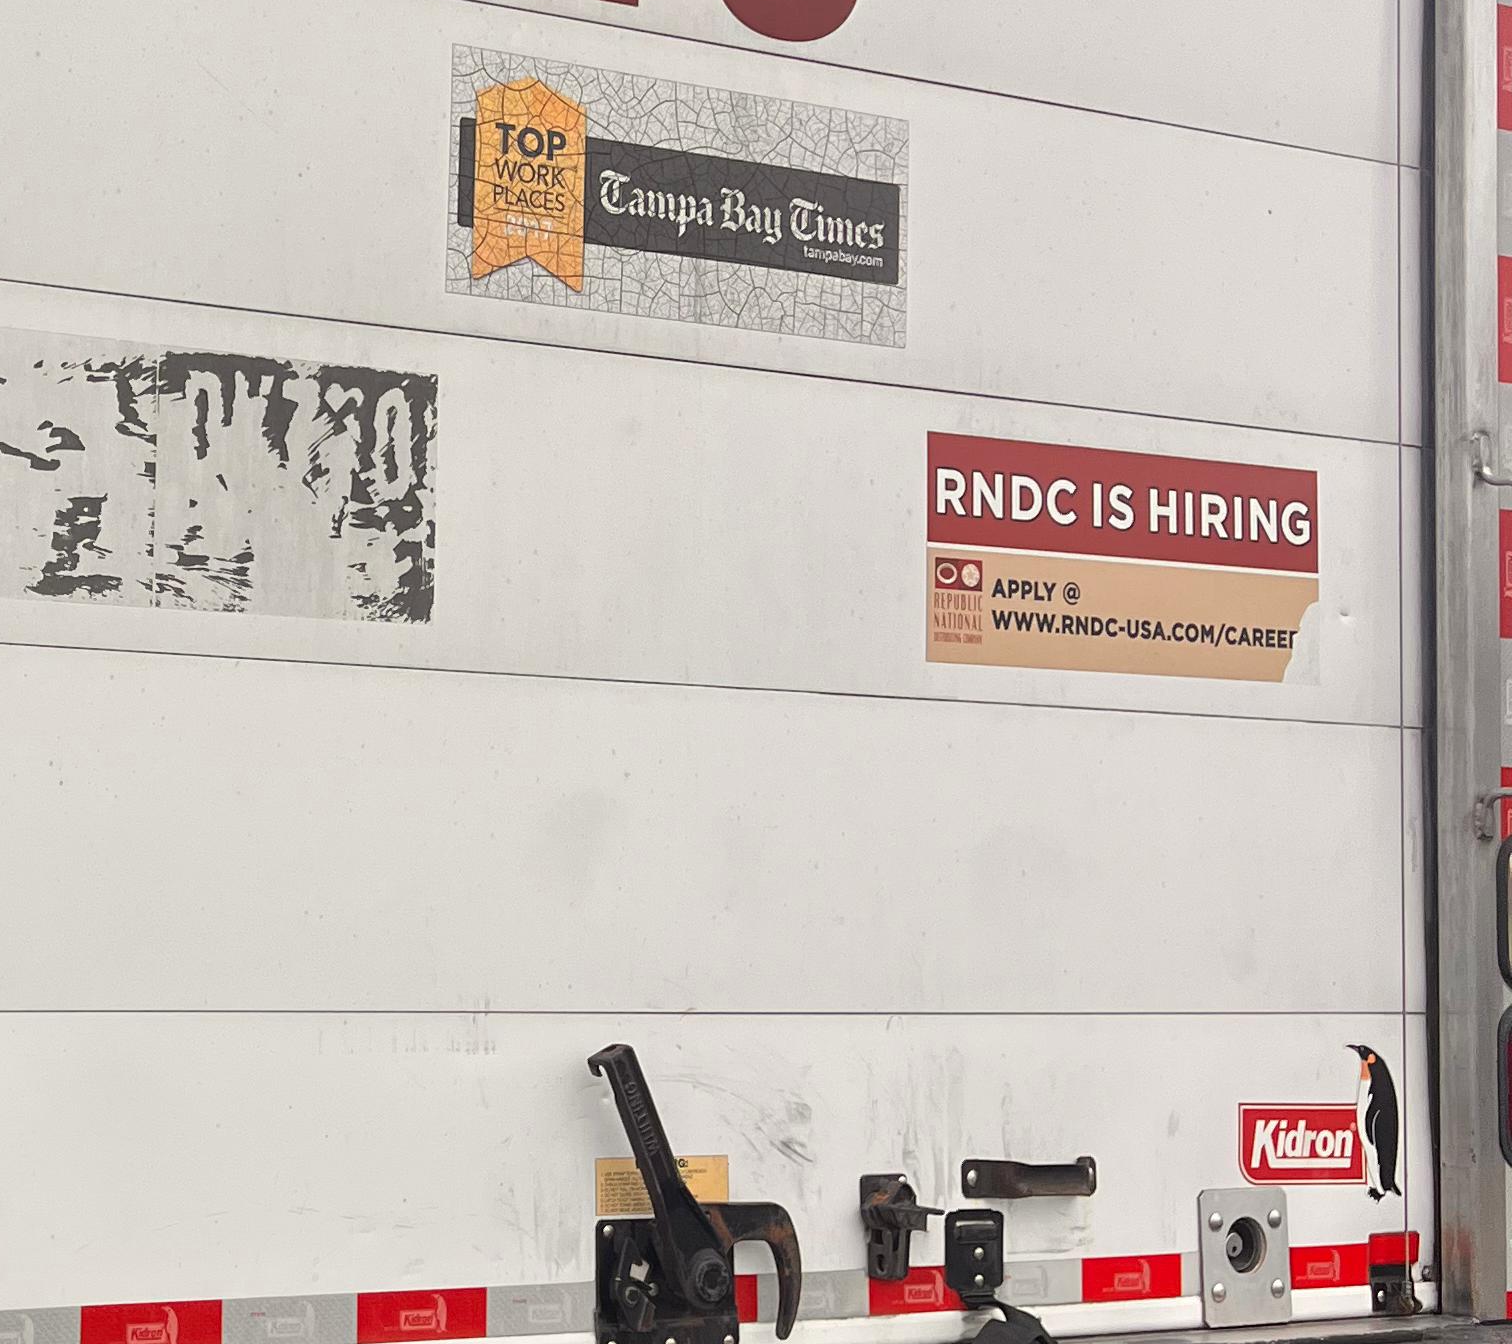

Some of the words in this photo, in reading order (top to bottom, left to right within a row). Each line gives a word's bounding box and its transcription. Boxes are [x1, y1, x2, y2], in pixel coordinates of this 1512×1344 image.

[495, 122, 567, 162] TOP
[494, 158, 566, 190] WORK
[493, 184, 565, 212] PLACES
[598, 169, 715, 239] Tampa
[719, 187, 783, 246] Bay
[789, 197, 886, 250] Times
[802, 245, 884, 268] tampabay.com
[934, 467, 1079, 527] RNDC
[1091, 482, 1136, 532] IS
[1148, 487, 1313, 546] HIRING
[933, 592, 983, 613] REPUBLIC
[991, 577, 1057, 602] APPLY
[1062, 581, 1081, 606] @
[933, 613, 984, 633] NATIONAL
[1250, 1119, 1354, 1169] Kidron
[131, 1327, 164, 1341] Kidron
